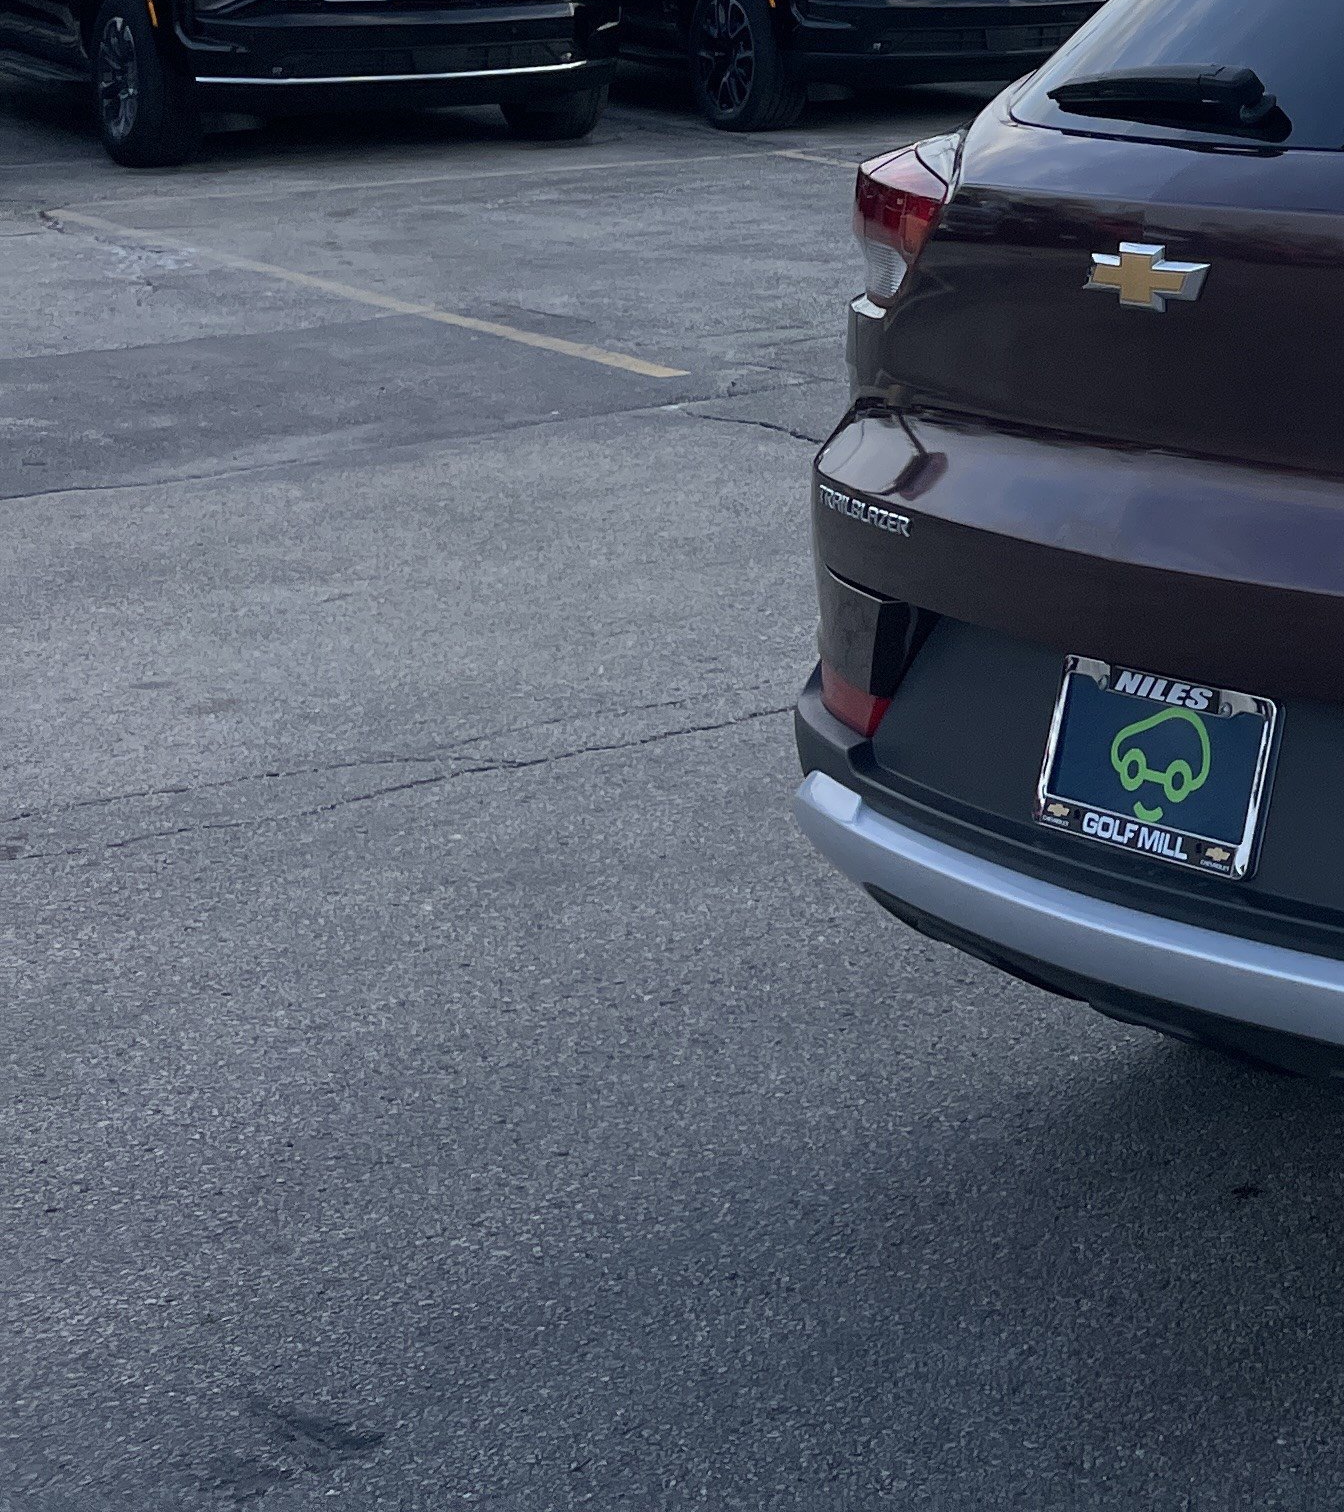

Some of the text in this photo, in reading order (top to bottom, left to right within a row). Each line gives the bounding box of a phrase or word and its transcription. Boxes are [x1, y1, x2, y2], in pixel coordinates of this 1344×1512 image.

[819, 484, 911, 538] TRAILBLAZER
[1114, 670, 1213, 711] NILES
[1082, 811, 1188, 861] GOLF MILL
